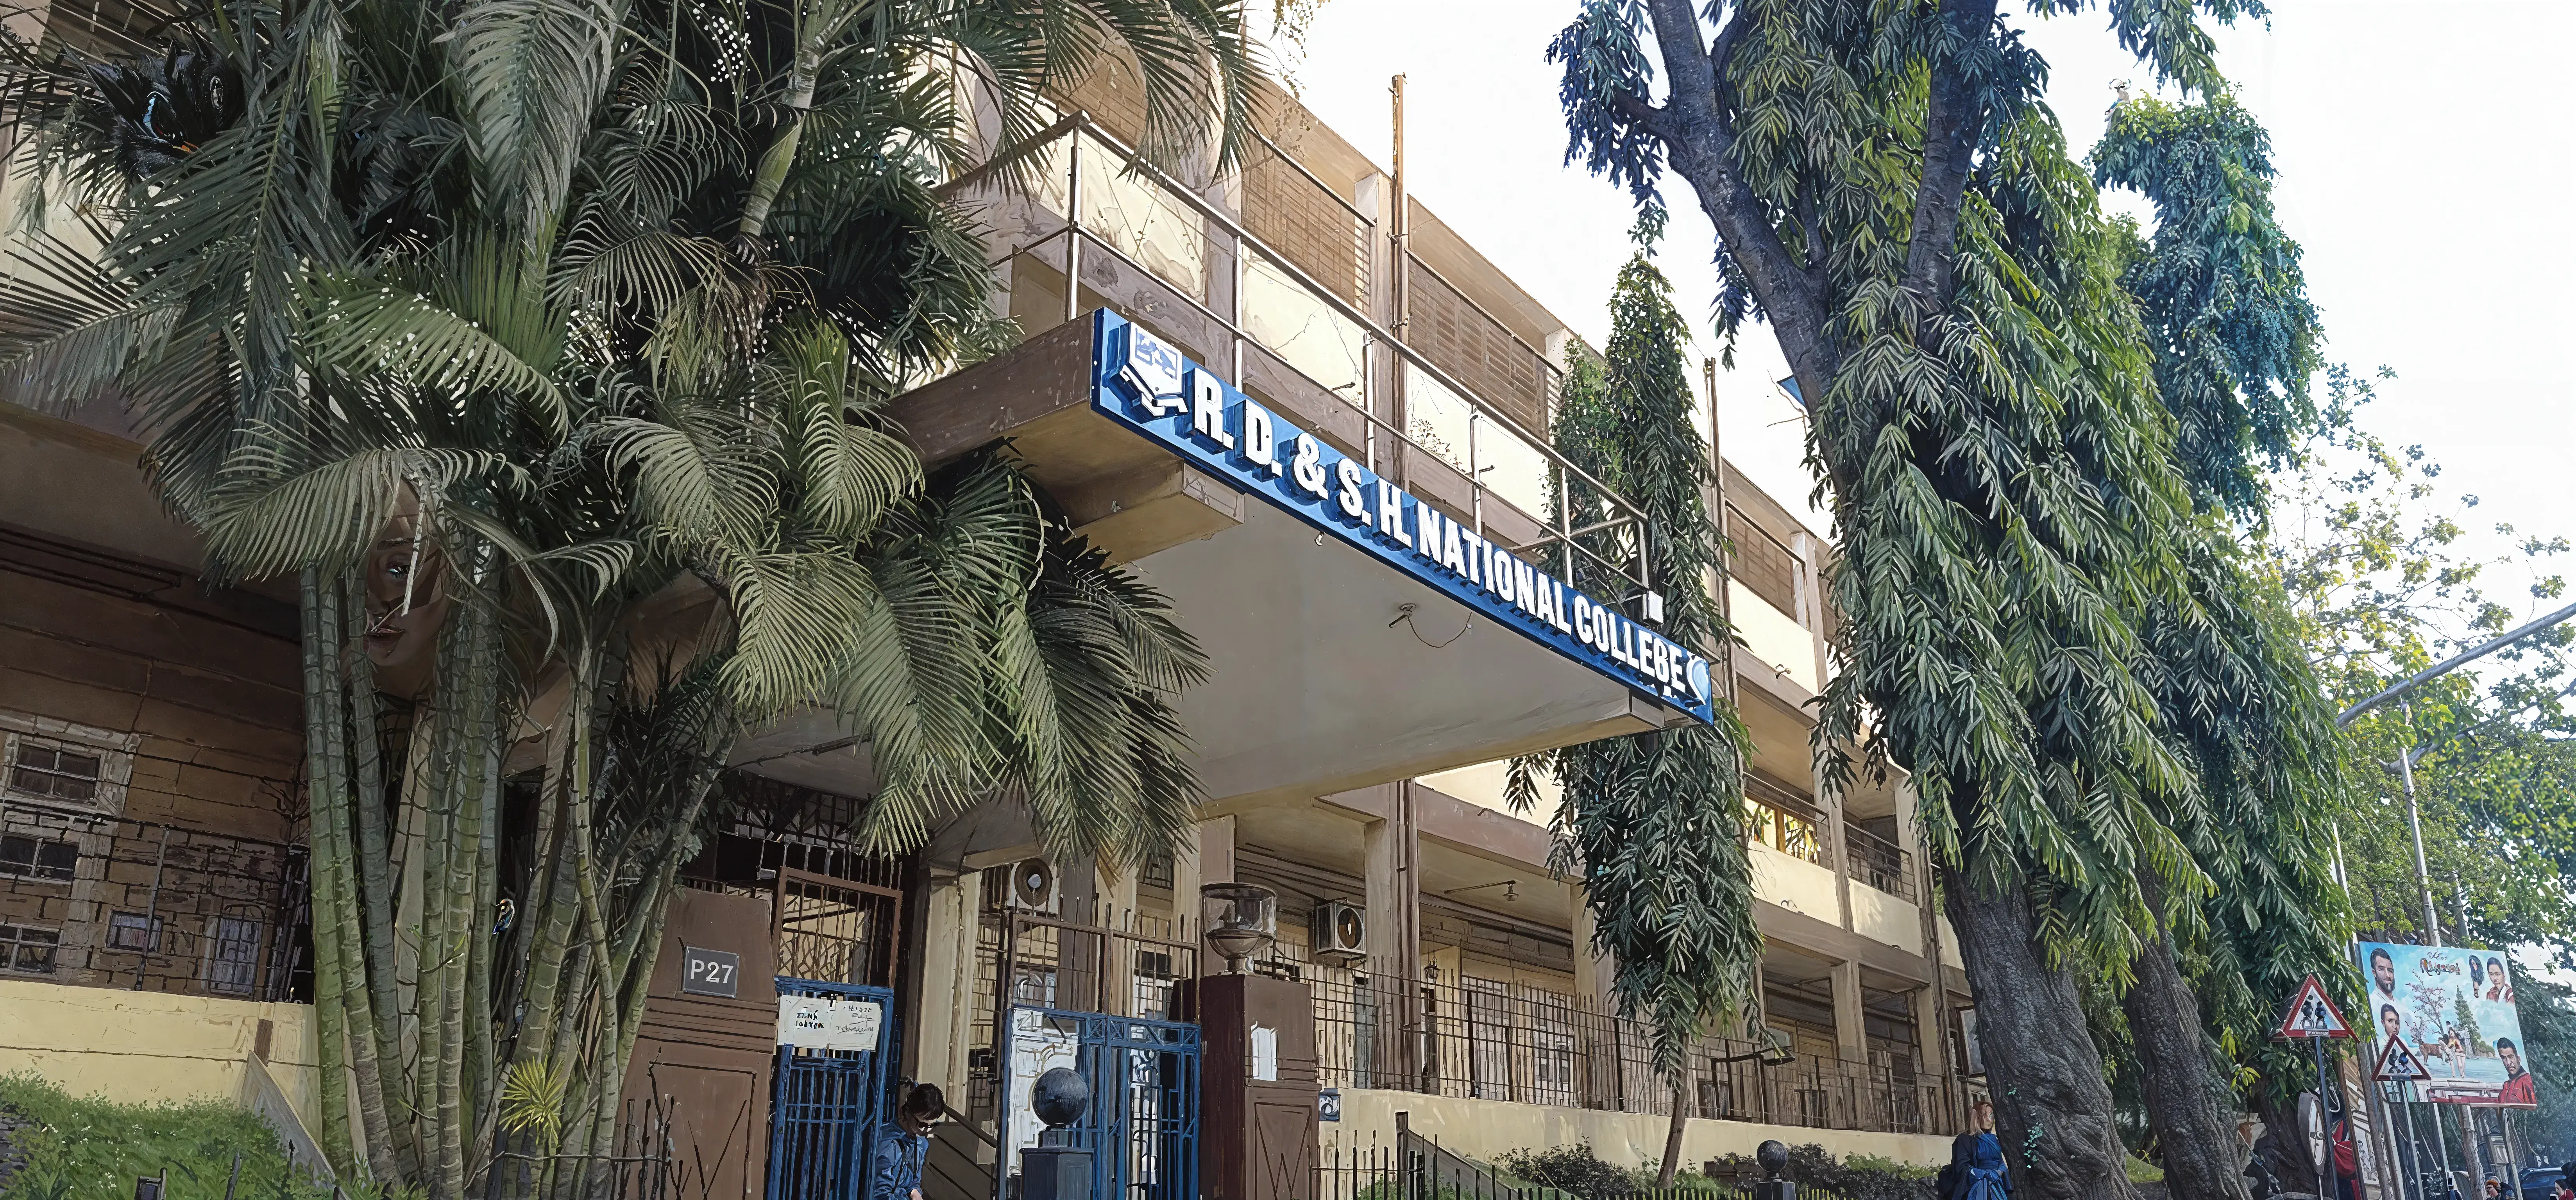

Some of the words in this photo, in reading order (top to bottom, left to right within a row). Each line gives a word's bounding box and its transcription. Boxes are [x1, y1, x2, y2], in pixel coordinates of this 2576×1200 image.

[1294, 432, 1329, 500] &
[1418, 501, 1571, 635] NATIONAL
[691, 959, 734, 983] P27
